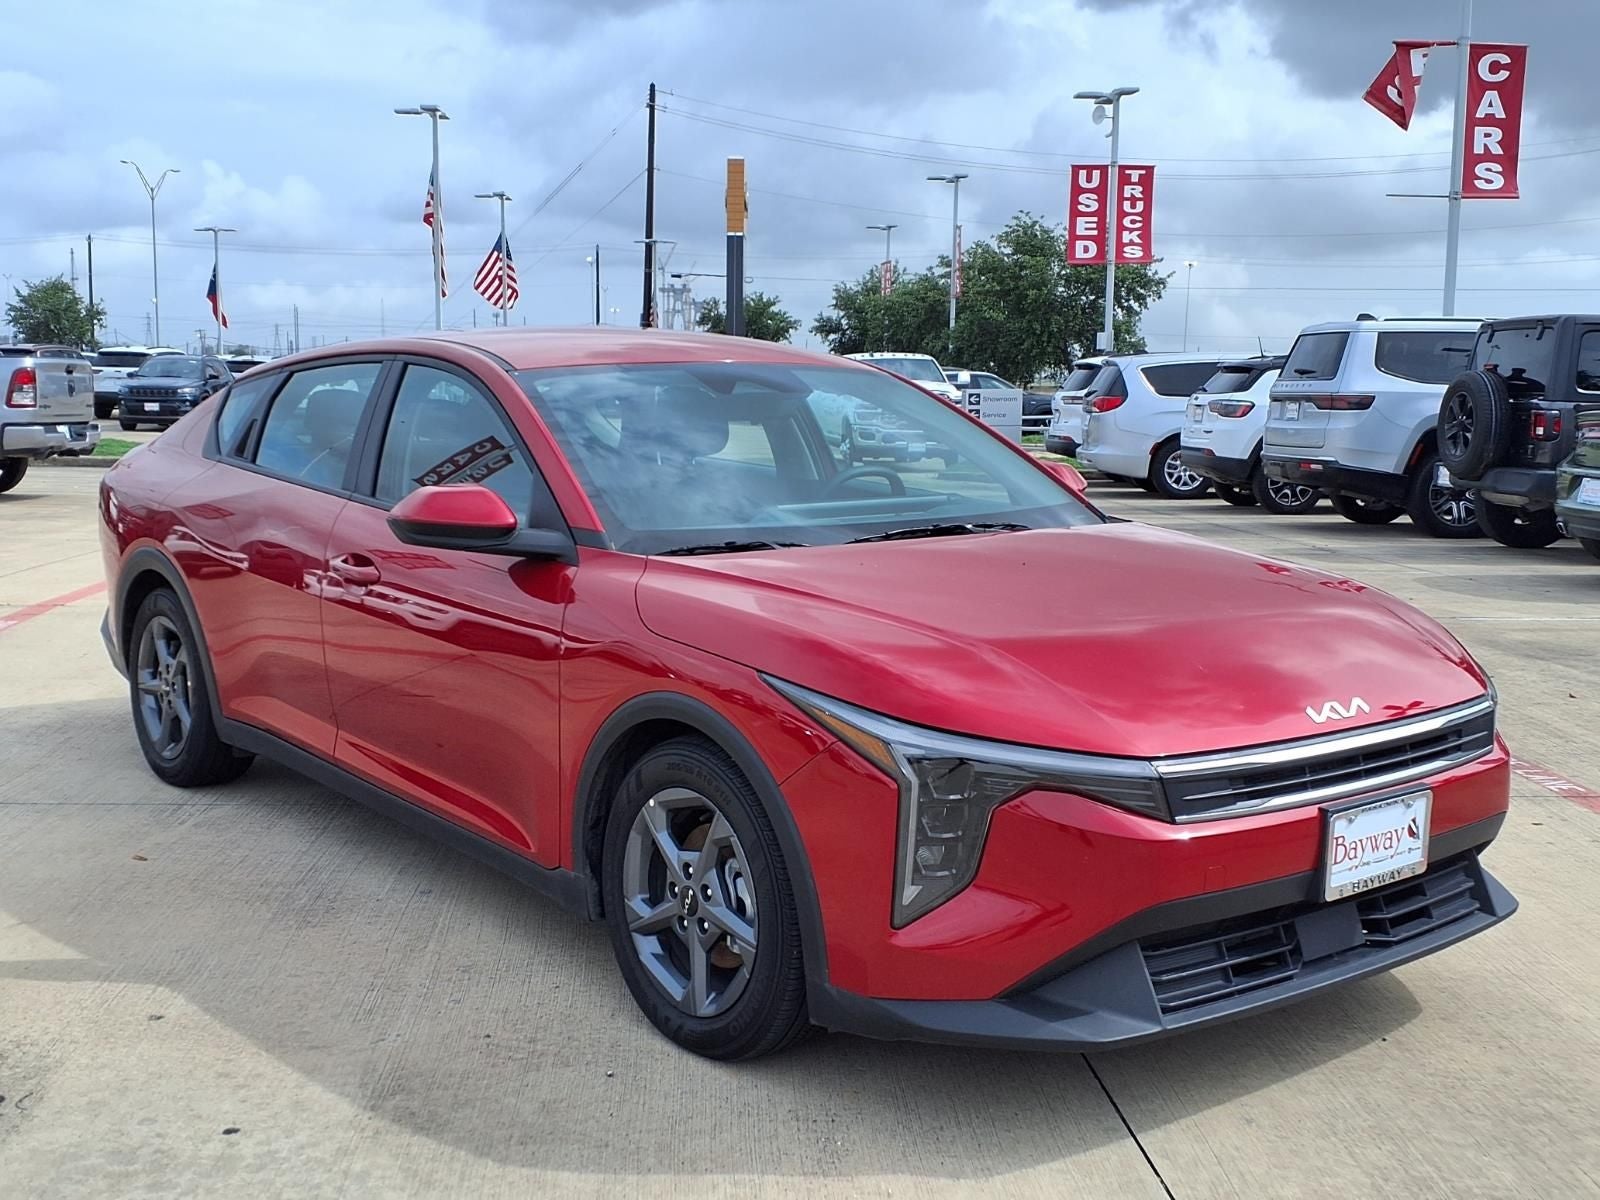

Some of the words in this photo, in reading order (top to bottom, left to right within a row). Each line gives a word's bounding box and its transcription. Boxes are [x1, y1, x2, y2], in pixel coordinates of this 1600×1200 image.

[1473, 53, 1511, 190] CARS
[1075, 169, 1101, 259] USED
[1122, 169, 1146, 259] TRUCKS
[1305, 697, 1371, 724] KIA
[1332, 827, 1406, 870] Bayway
[1351, 868, 1404, 893] BAYWAY
